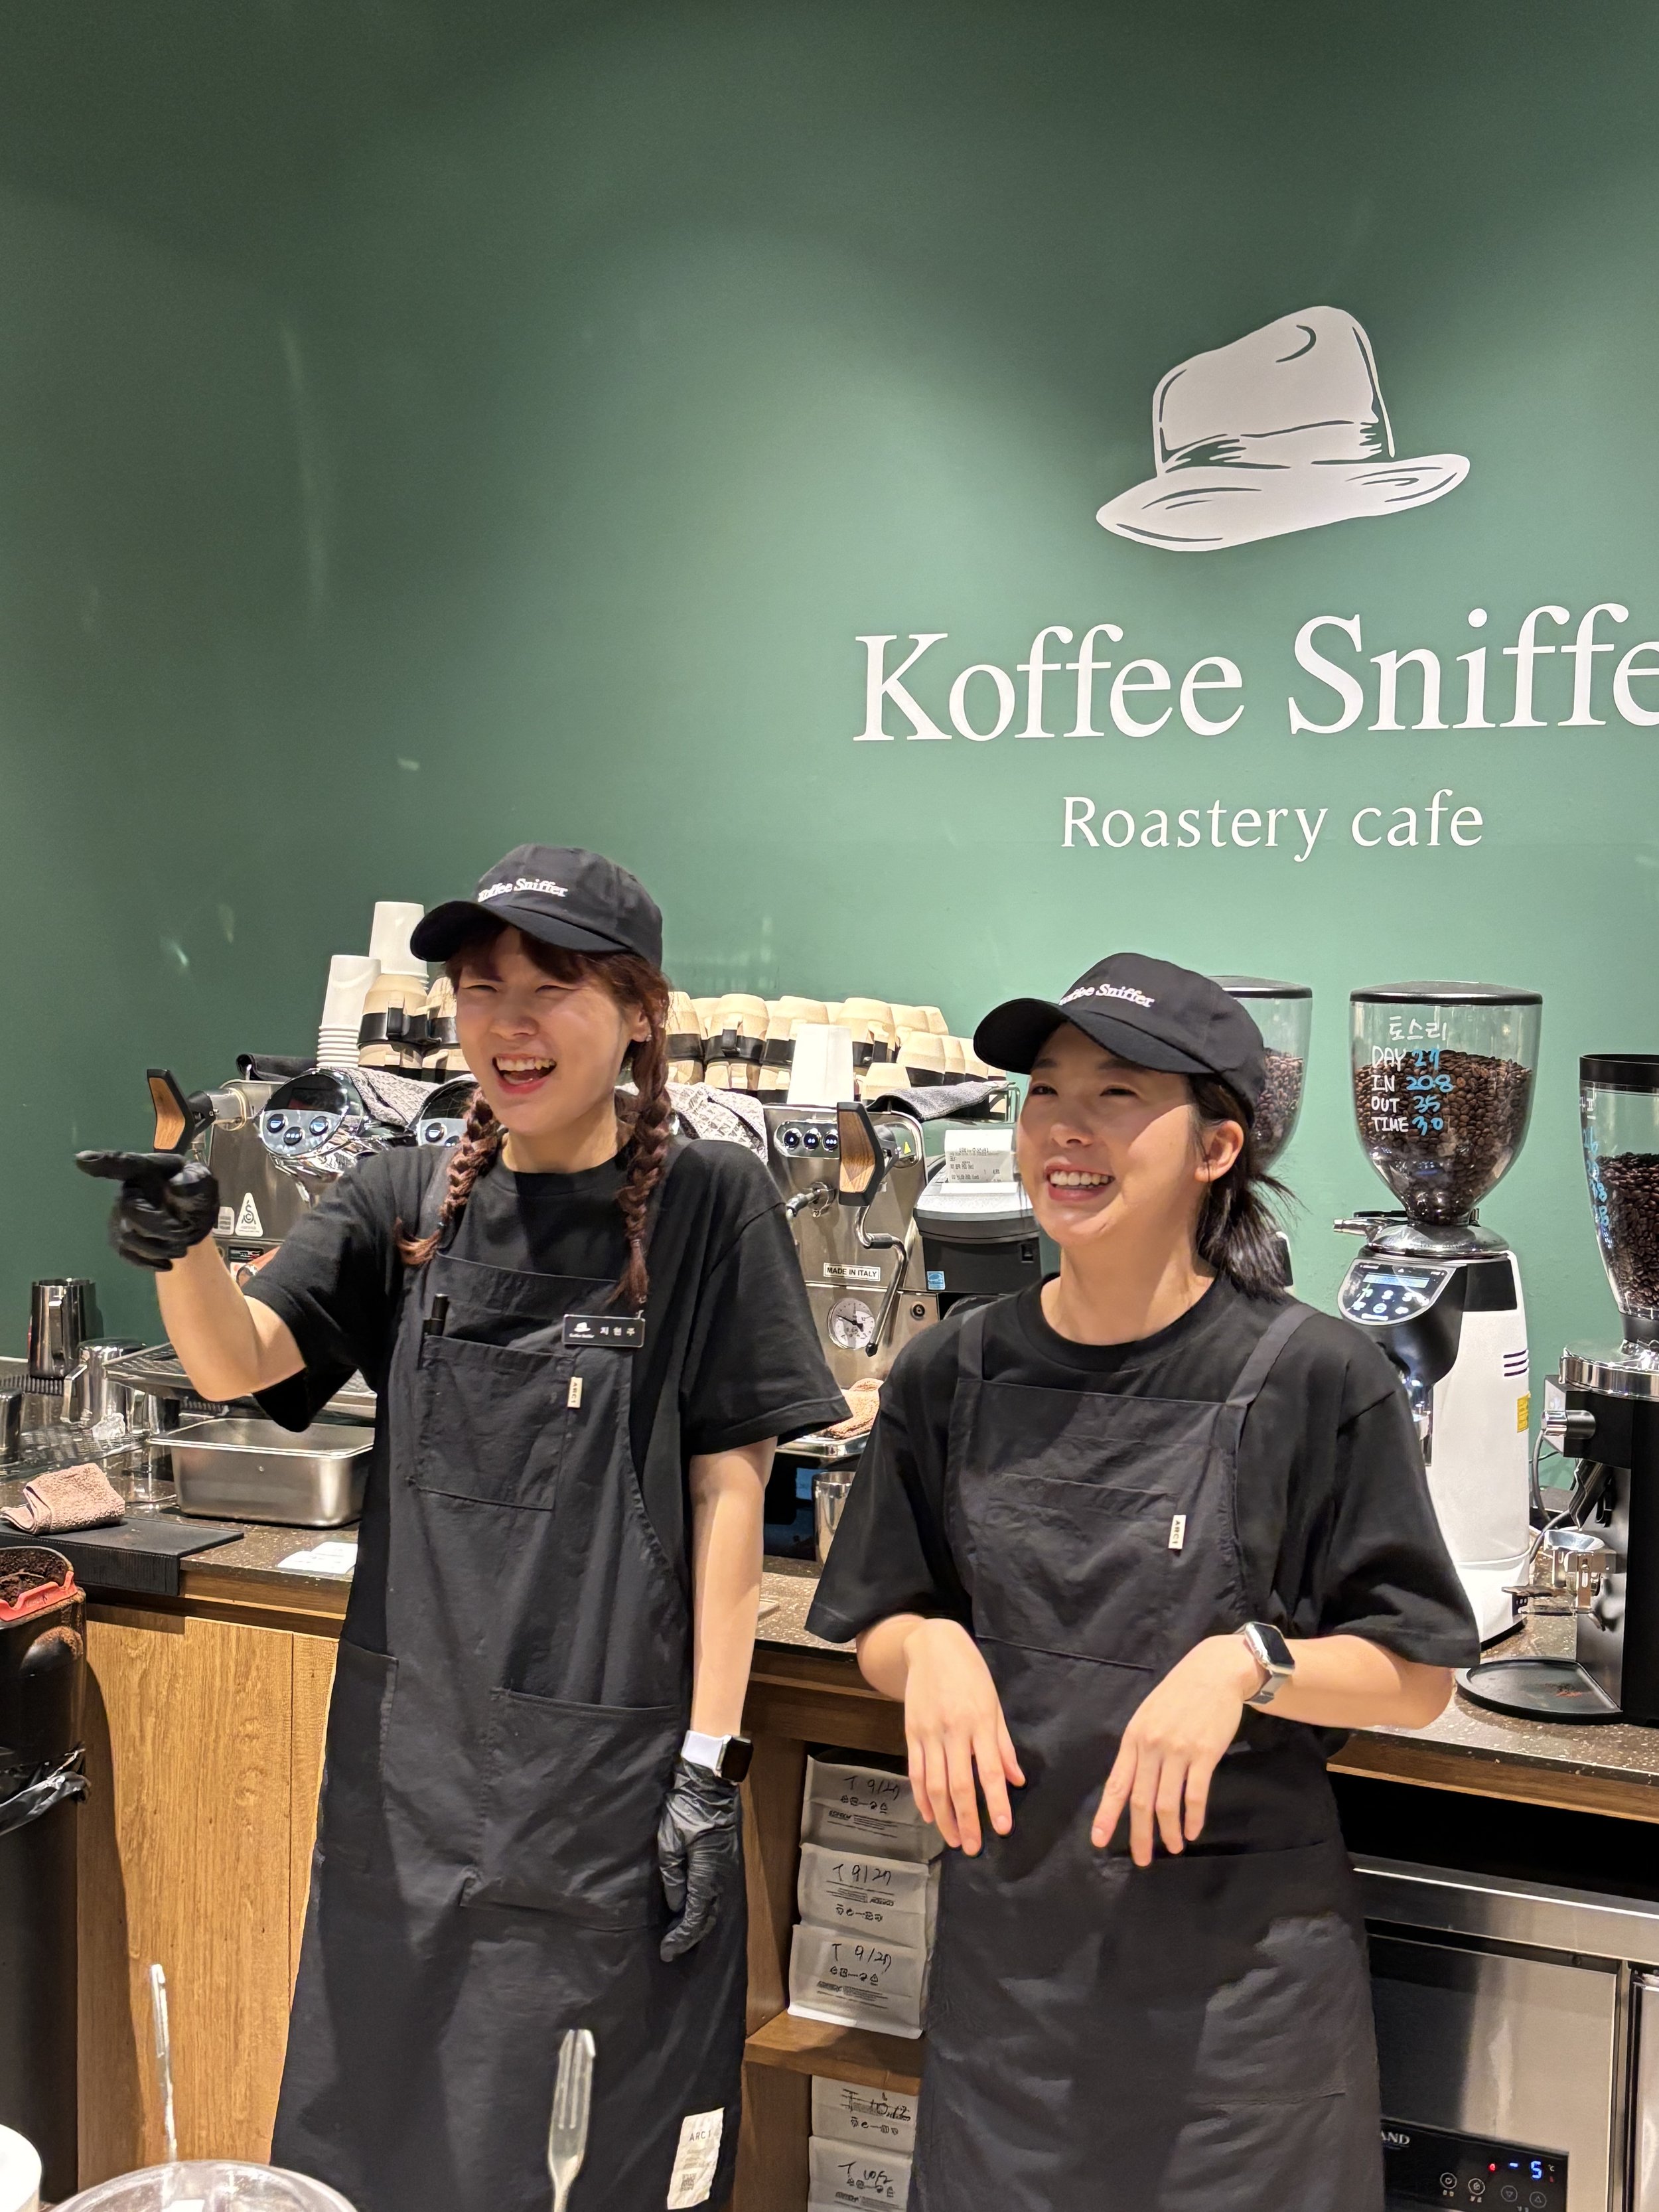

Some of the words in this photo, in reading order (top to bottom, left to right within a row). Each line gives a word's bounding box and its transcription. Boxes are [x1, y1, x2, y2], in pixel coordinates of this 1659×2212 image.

[853, 623, 1245, 742] Koffee
[1062, 796, 1329, 863] Roastery
[1351, 788, 1484, 847] cafe
[514, 878, 569, 897] Sniffer
[1096, 984, 1155, 1007] Sniffer
[1372, 1045, 1407, 1072] DAY
[1411, 1049, 1441, 1070] 27
[1371, 1074, 1396, 1092] IN
[1371, 1096, 1400, 1113] OUT
[1413, 1094, 1441, 1114] 35
[1371, 1116, 1409, 1133] TIME
[832, 1864, 844, 1881] T
[851, 1864, 892, 1886] 9/27
[831, 1943, 842, 1961] T
